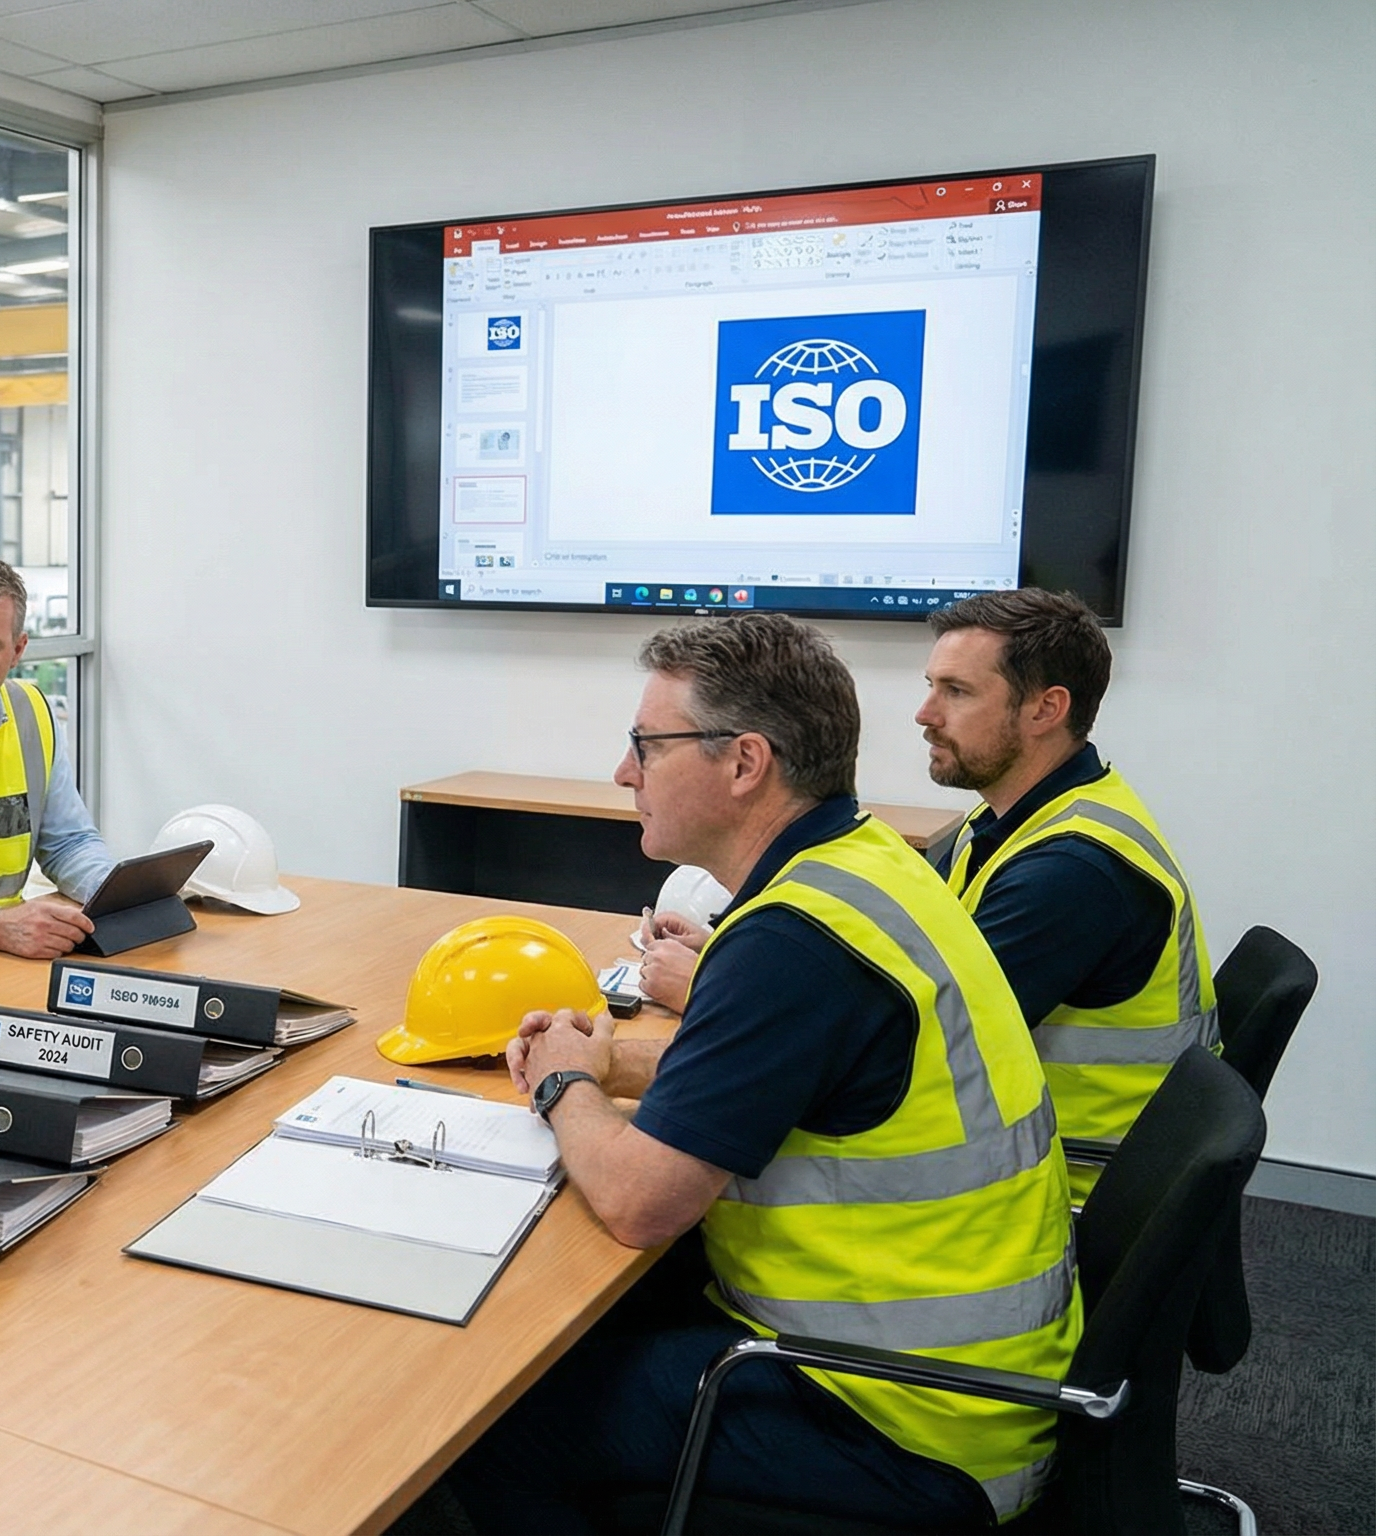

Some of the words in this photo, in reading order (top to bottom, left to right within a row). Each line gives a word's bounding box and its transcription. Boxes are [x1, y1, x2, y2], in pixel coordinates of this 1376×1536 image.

[488, 325, 520, 341] ISO
[728, 379, 908, 451] ISO
[7, 1024, 60, 1044] SAFETY
[61, 1033, 104, 1051] AUDIT
[38, 1048, 69, 1064] 2024
